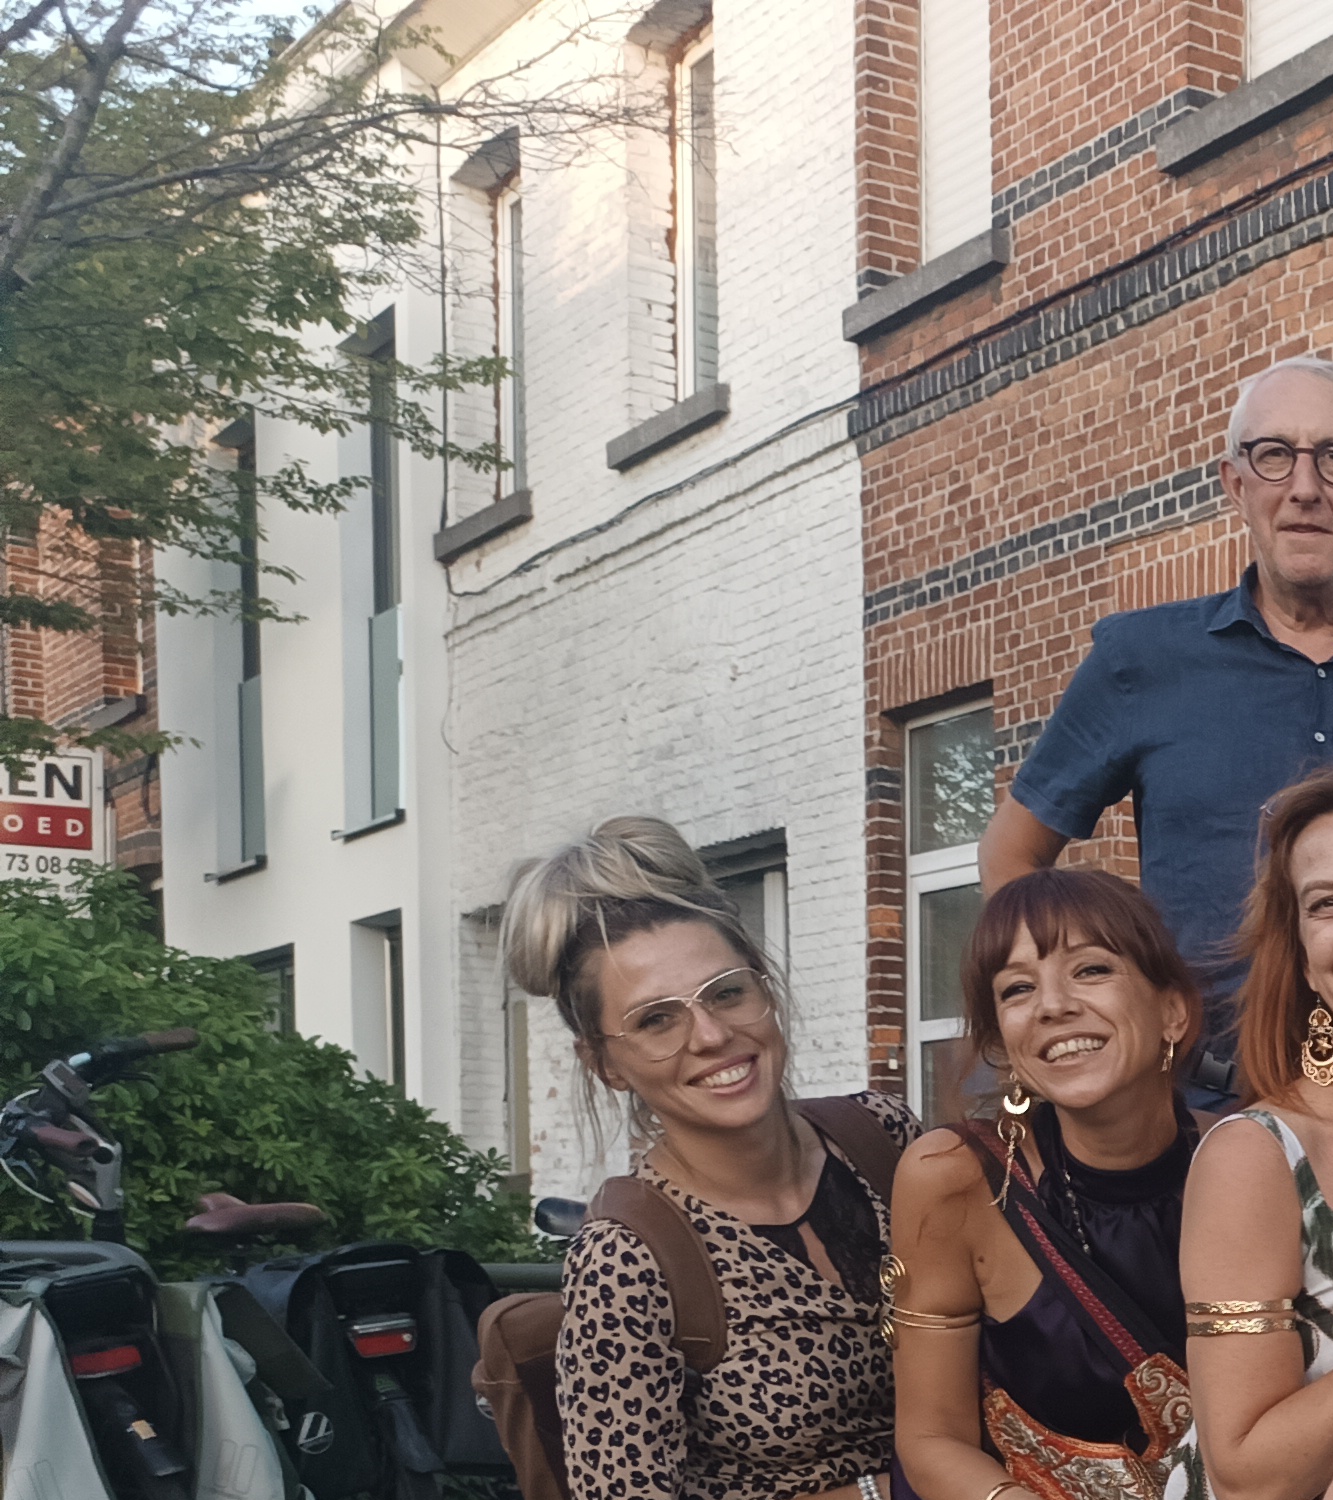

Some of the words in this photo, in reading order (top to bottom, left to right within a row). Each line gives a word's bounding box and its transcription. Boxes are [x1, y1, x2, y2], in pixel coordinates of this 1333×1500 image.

[0, 761, 83, 801] EN
[3, 813, 84, 837] OED
[5, 852, 30, 872] 73
[35, 855, 61, 874] 08
